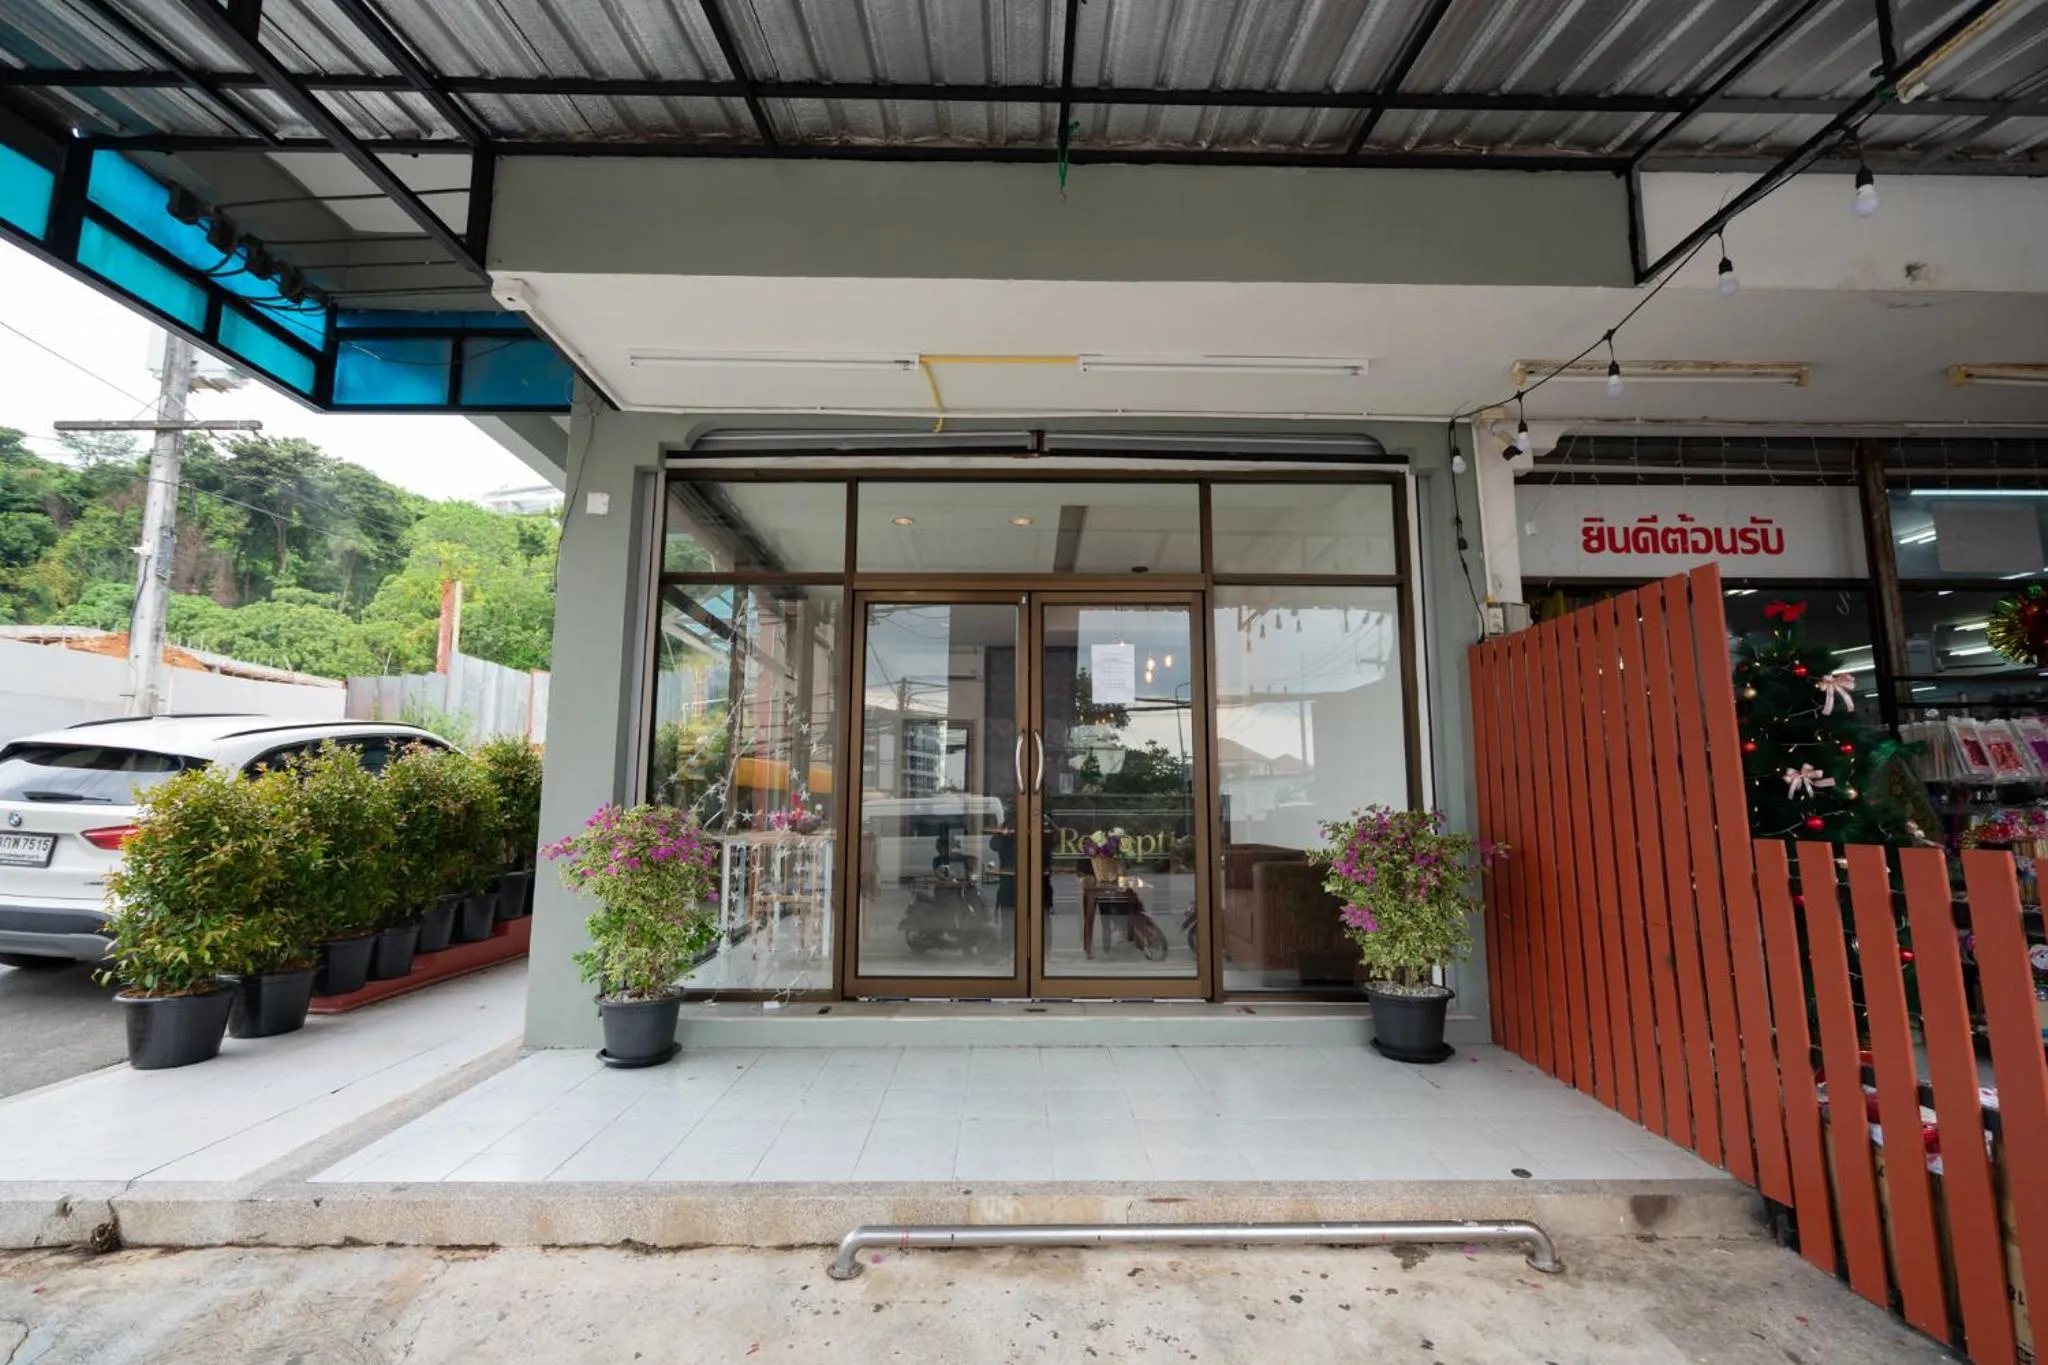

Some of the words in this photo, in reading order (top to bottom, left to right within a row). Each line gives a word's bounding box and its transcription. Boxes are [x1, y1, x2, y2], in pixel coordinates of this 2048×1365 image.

[1582, 513, 1785, 555] ยินดีต้อนรับ
[22, 837, 50, 851] 7515
